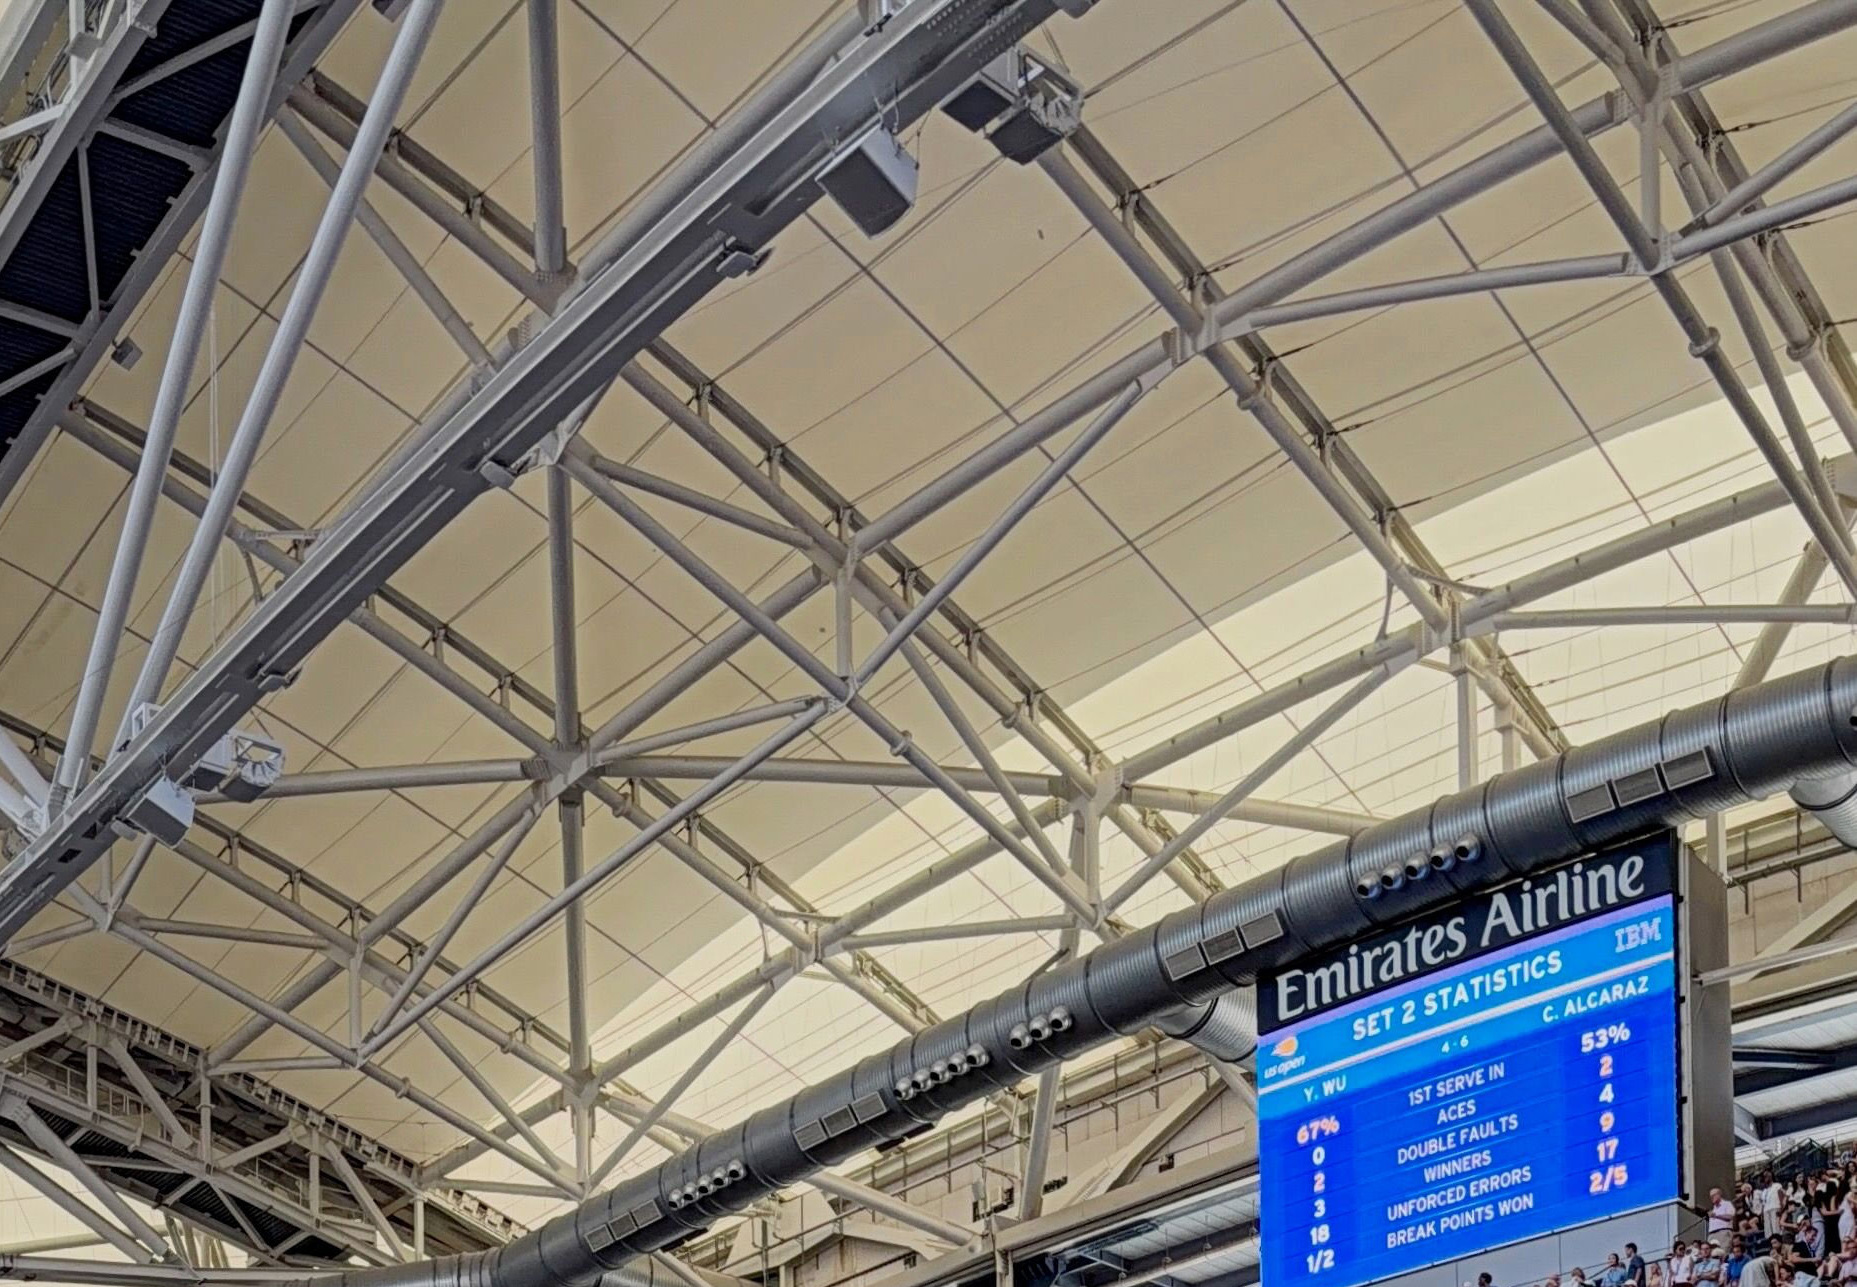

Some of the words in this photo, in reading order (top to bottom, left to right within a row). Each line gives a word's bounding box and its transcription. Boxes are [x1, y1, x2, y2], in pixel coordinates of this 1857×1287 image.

[1277, 917, 1467, 1021] Emirates
[1481, 855, 1646, 946] Airline
[1615, 917, 1661, 952] IBM
[1353, 1012, 1394, 1040] SET
[1402, 1002, 1415, 1024] 2
[1423, 951, 1564, 1017] STATISTICS
[1543, 1006, 1558, 1022] C.
[1565, 976, 1649, 1016] ALCARAZ
[1297, 1116, 1339, 1144] 67%
[1409, 1085, 1432, 1105] 1ST
[1437, 1069, 1484, 1097] SERVE
[1489, 1063, 1504, 1080] IN
[1582, 1023, 1630, 1052] 53%
[1304, 1087, 1317, 1101] Y.
[1323, 1076, 1346, 1096] WU
[1437, 1100, 1476, 1124] ACES
[1600, 1056, 1612, 1076] 2
[1314, 1173, 1325, 1192] 2
[1398, 1132, 1459, 1164] DOUBLE
[1460, 1114, 1518, 1144] FAULTS
[1600, 1084, 1614, 1102] 4
[1307, 1249, 1334, 1273] 1/2
[1388, 1221, 1436, 1248] BREAK
[1441, 1205, 1494, 1233] POINTS
[1498, 1193, 1533, 1216] WON
[1590, 1165, 1628, 1193] 2/5
[1311, 1225, 1329, 1244] 18
[1388, 1185, 1466, 1220] UNFORCED
[1468, 1166, 1531, 1197] ERRORS
[1597, 1138, 1618, 1161] 17
[1314, 1199, 1325, 1217] 3
[1424, 1149, 1491, 1182] WINNERS
